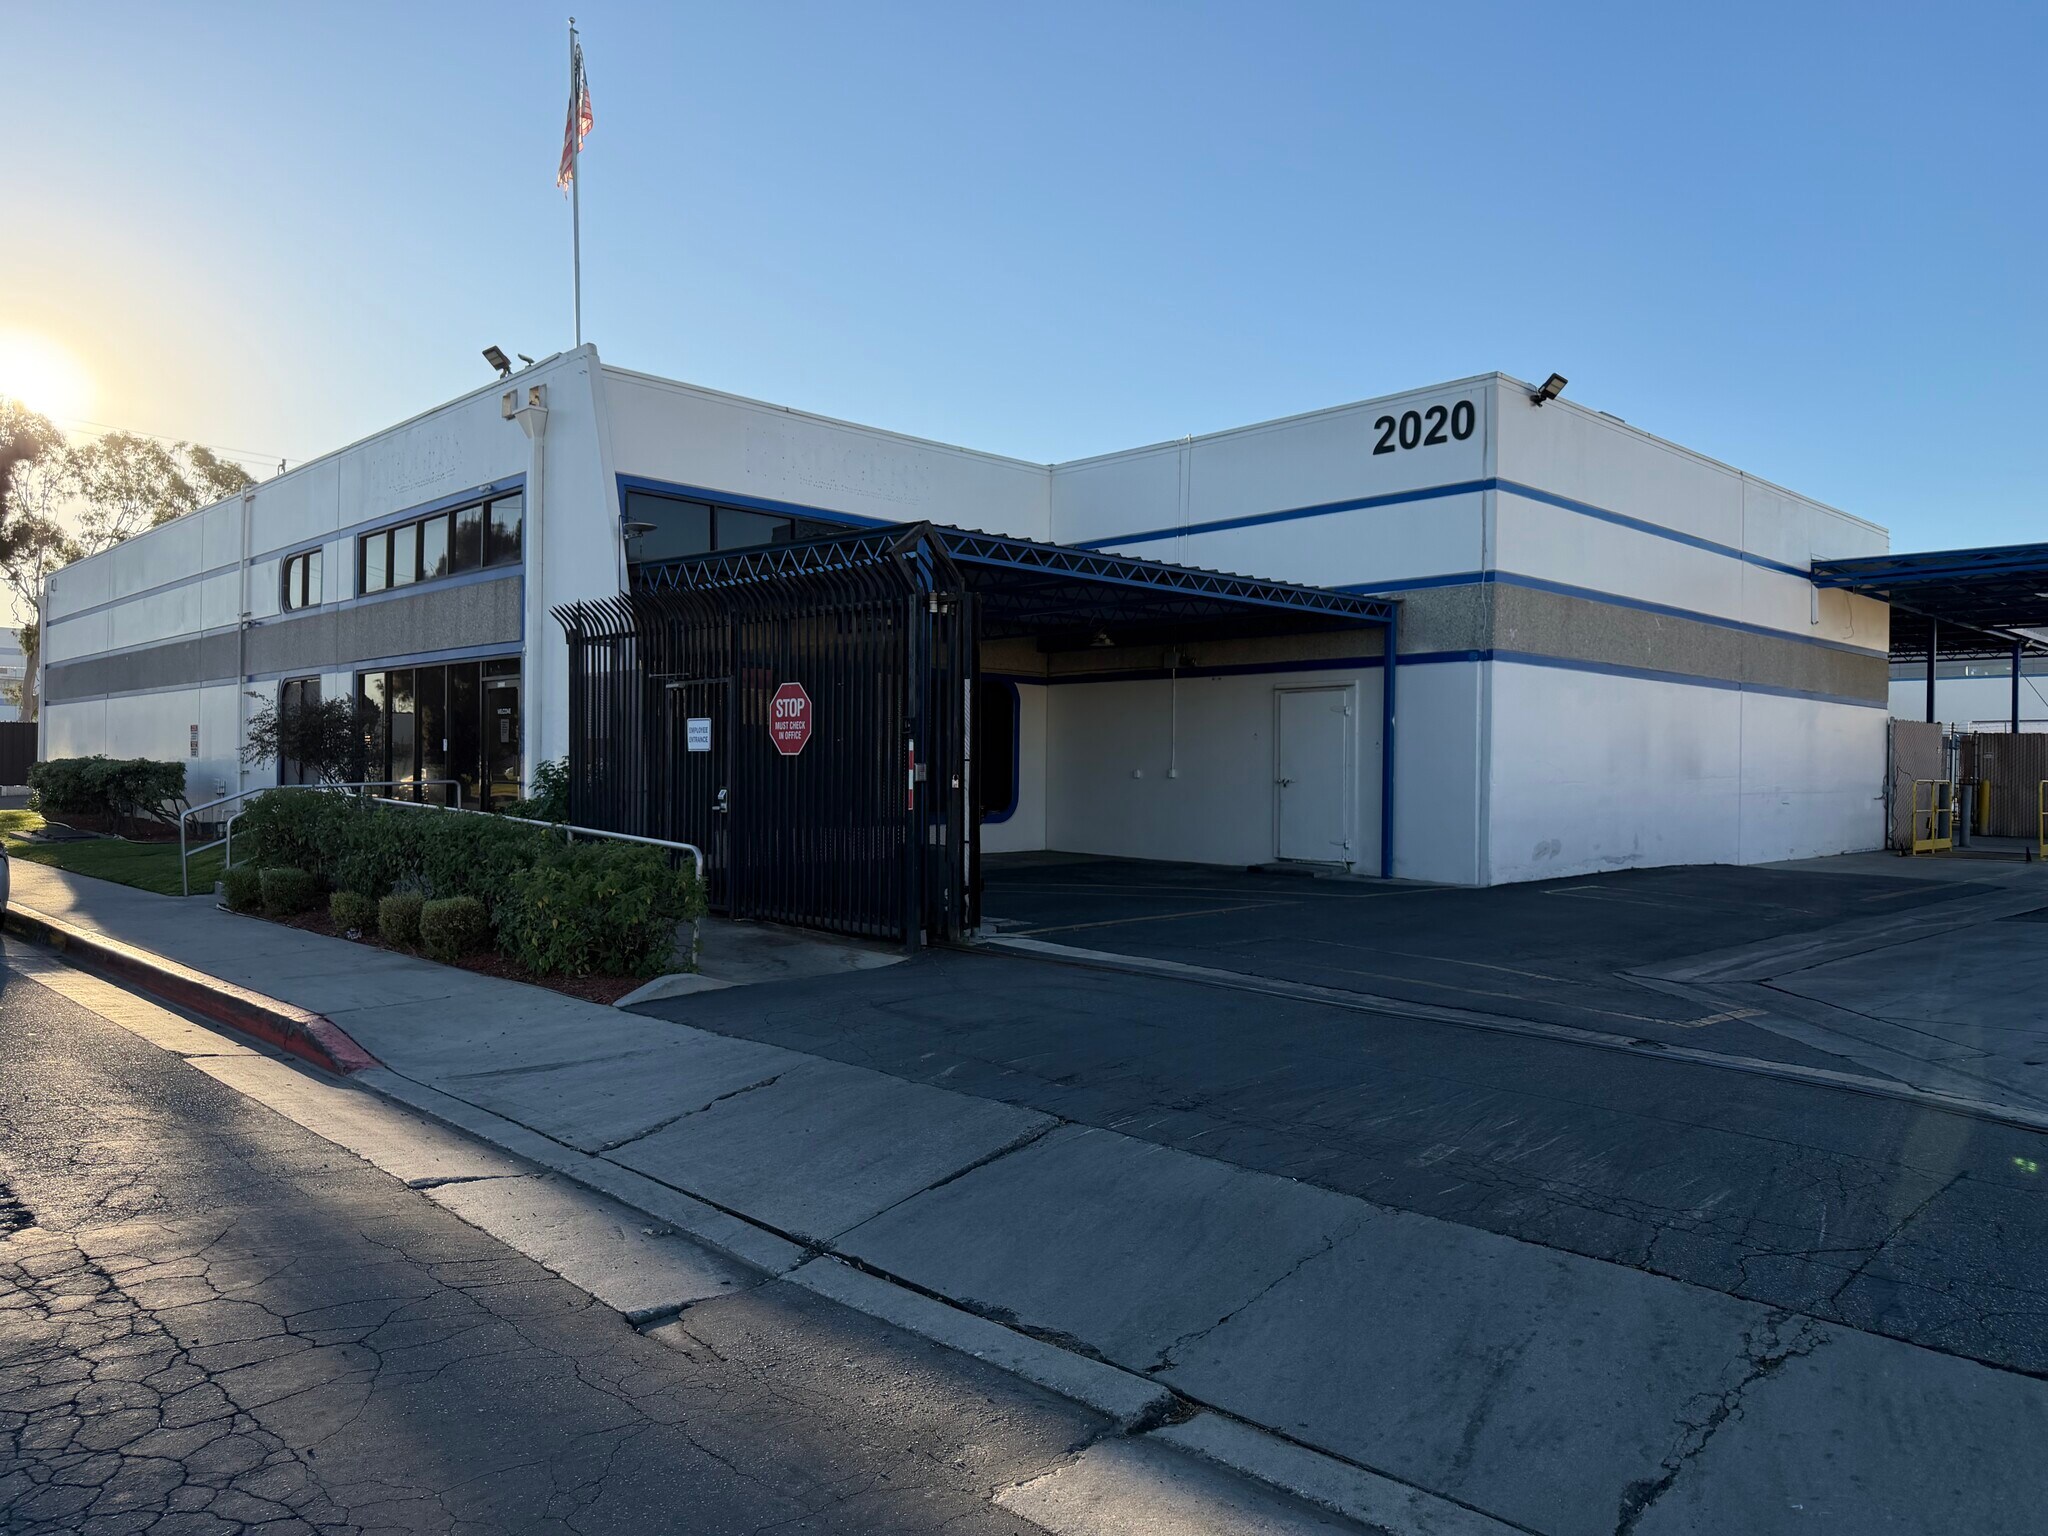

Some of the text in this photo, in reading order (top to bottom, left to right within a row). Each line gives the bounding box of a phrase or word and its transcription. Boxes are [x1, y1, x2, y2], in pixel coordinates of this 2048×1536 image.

[1373, 400, 1475, 455] 2020
[776, 698, 805, 717] STOP
[775, 721, 805, 729] MUST CHECK
[779, 731, 801, 739] IN OFFICE
